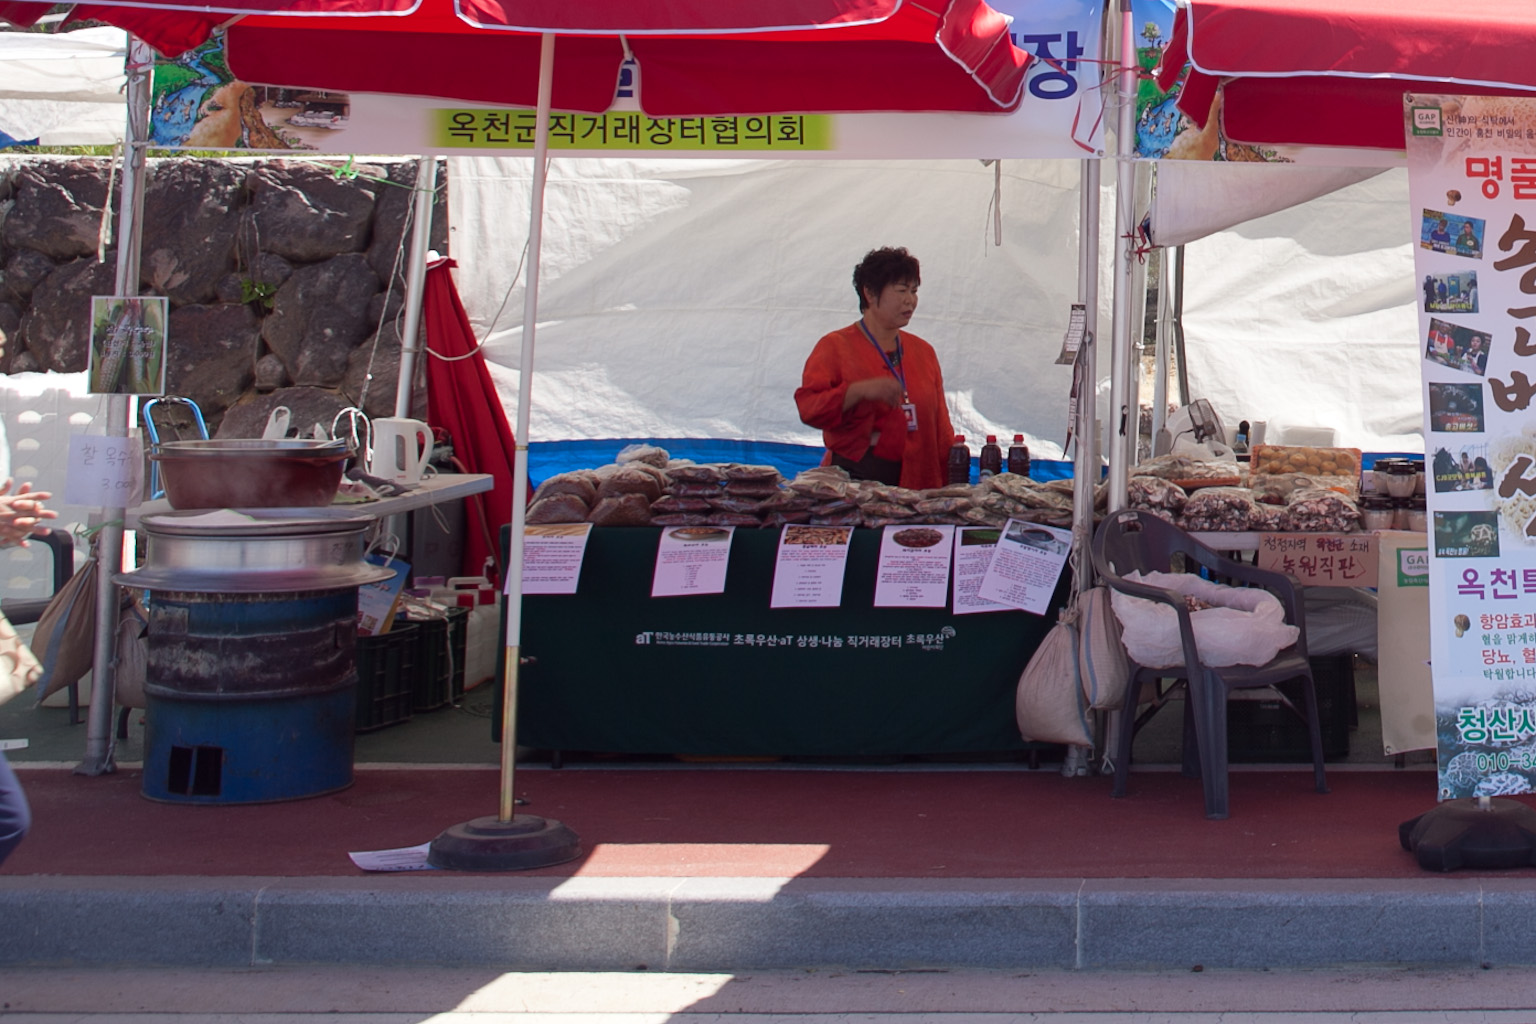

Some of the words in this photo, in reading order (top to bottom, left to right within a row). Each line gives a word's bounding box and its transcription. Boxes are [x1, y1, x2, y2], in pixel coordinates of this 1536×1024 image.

[1418, 113, 1437, 121] GAP
[448, 112, 805, 145] 옥천군직거래장터협의회
[1446, 128, 1472, 138] 인간이
[1497, 128, 1522, 139] 비밀의
[1264, 536, 1307, 552] 청정지역
[1350, 539, 1369, 553] 소재
[1407, 555, 1429, 565] GA
[847, 635, 902, 648] 직거래장터
[905, 633, 944, 645] 초록우산
[1482, 633, 1502, 646] 혈을
[1482, 649, 1516, 665] 당뇨,
